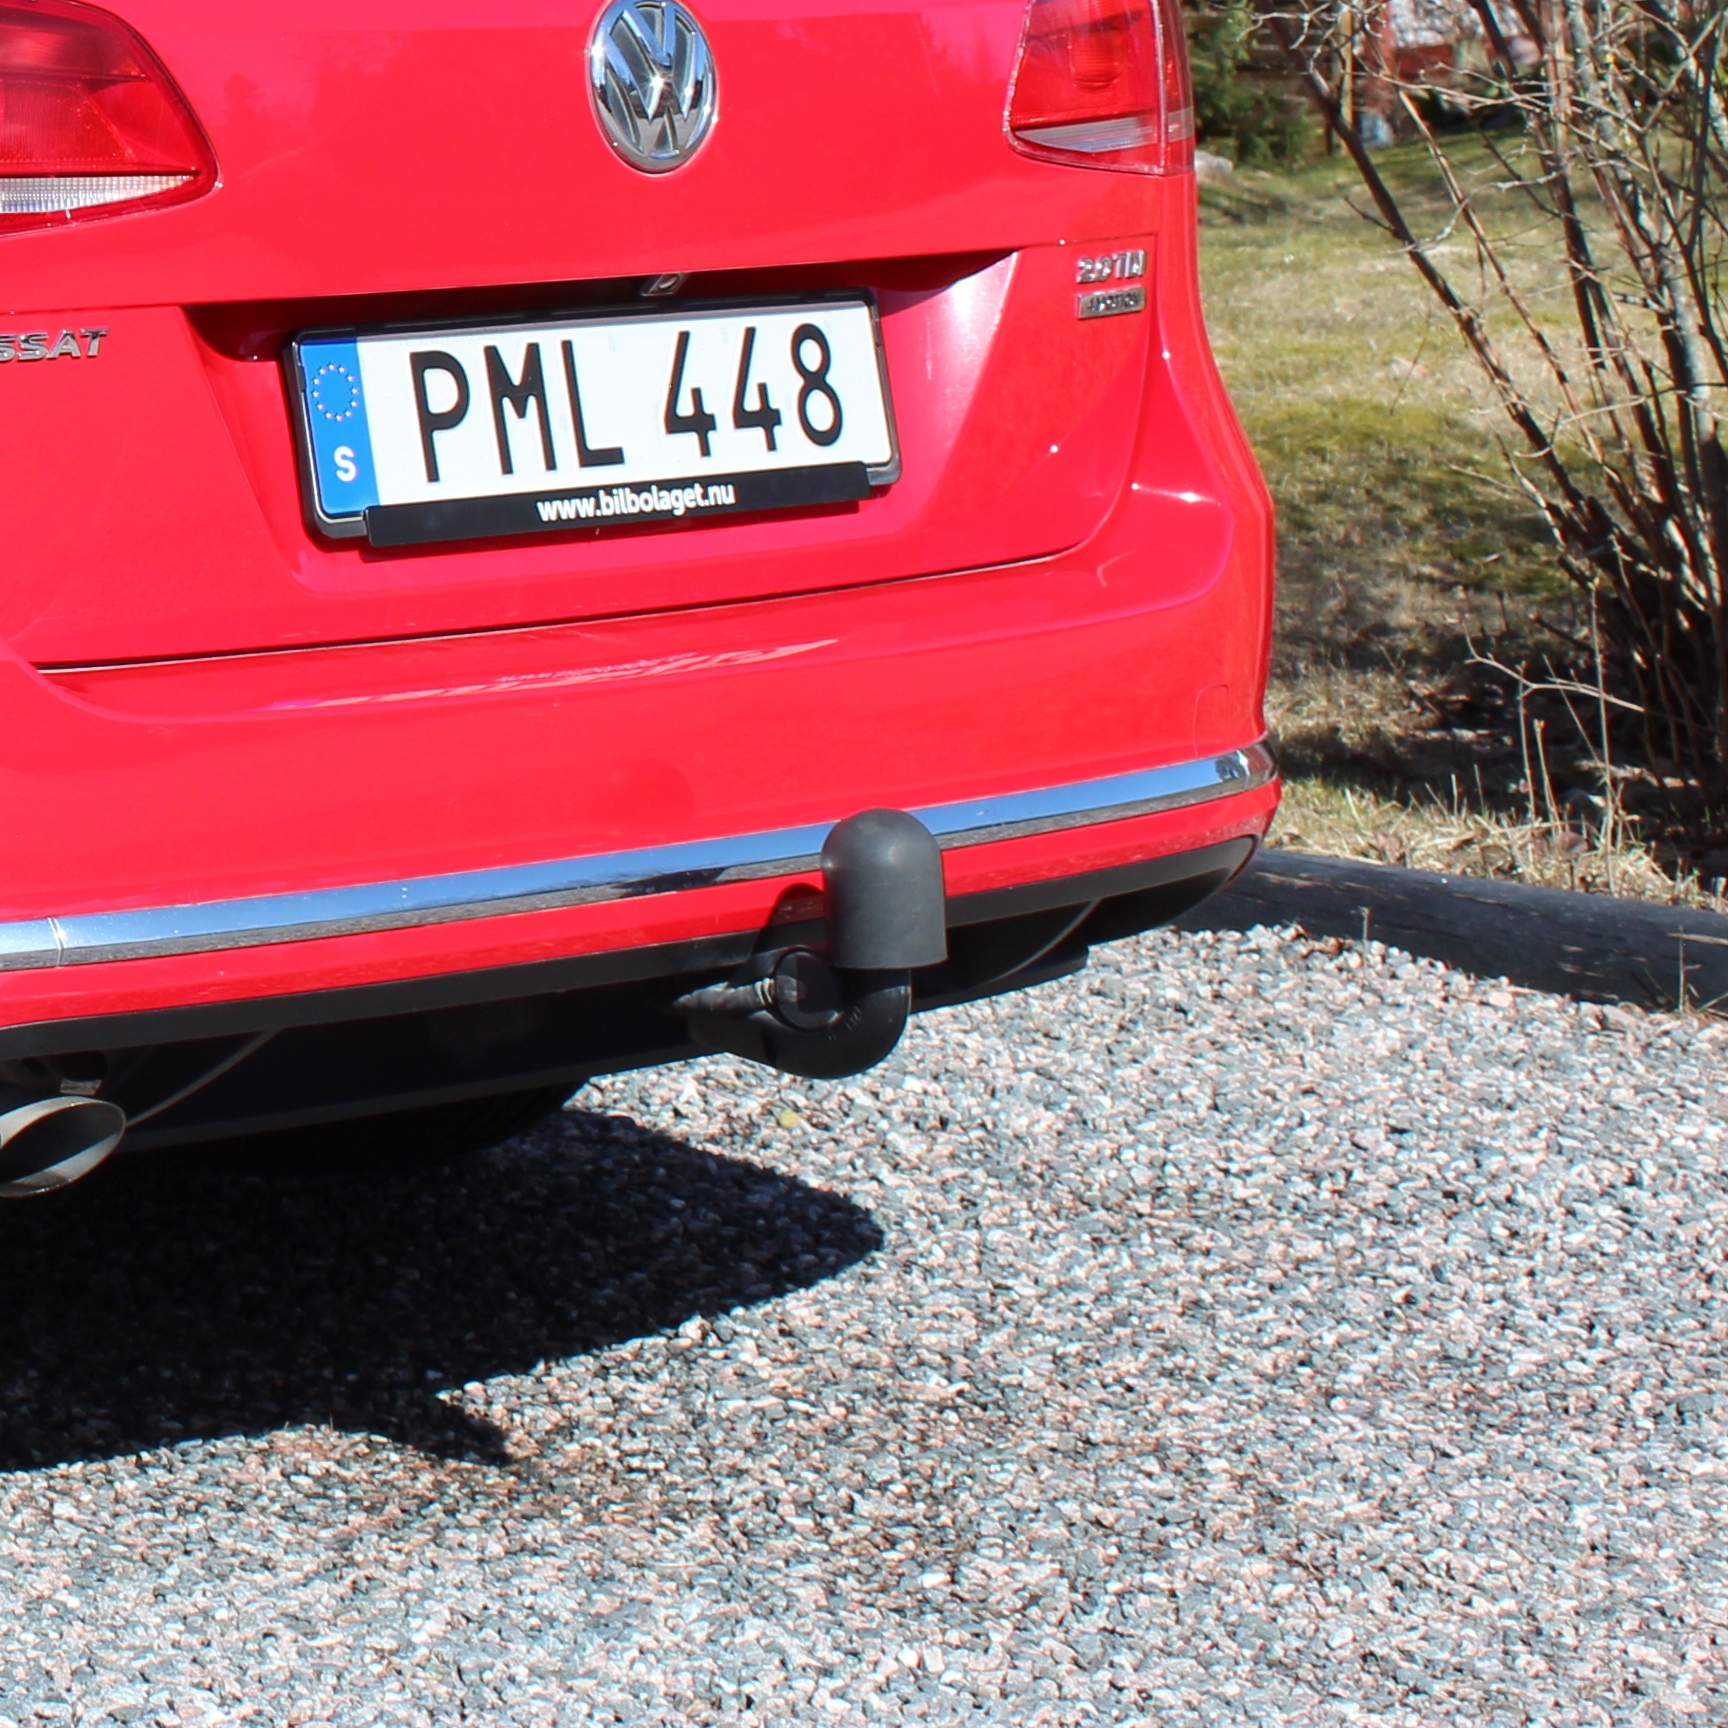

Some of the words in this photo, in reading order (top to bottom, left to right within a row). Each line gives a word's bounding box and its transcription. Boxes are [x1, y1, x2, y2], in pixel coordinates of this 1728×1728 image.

[408, 339, 625, 484] PML
[664, 323, 843, 458] 448
[334, 445, 357, 482] S
[536, 481, 736, 523] www.bilbolaget.nu
